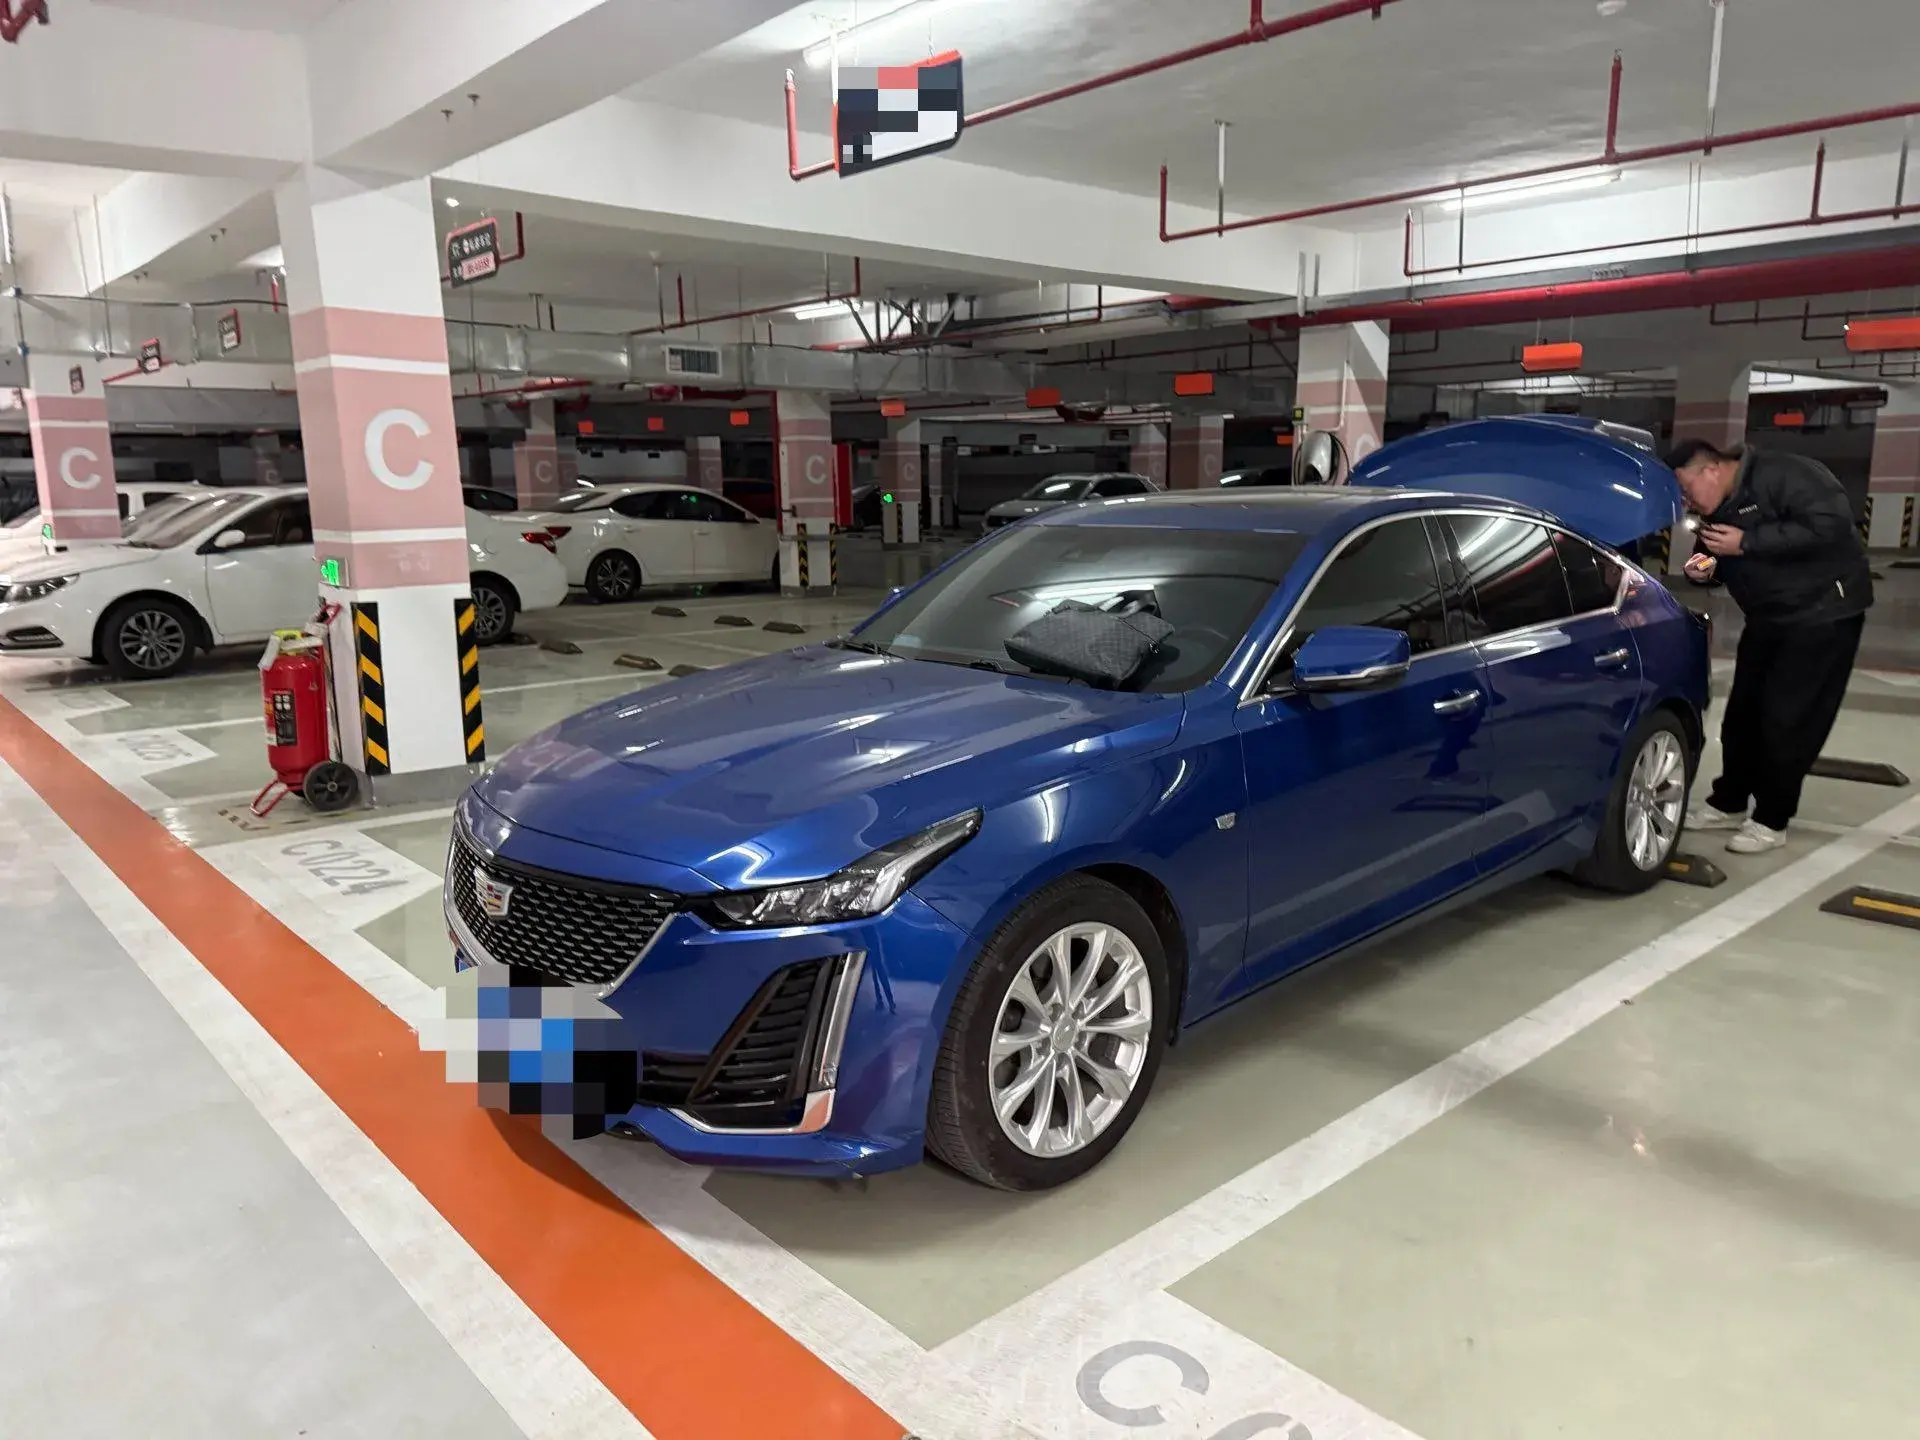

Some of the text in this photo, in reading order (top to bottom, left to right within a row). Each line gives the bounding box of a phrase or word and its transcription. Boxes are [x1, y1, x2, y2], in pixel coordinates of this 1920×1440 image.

[364, 408, 435, 491] C
[60, 447, 102, 490] C
[535, 460, 552, 482] C
[705, 466, 716, 482] C
[806, 455, 827, 484] C
[281, 840, 409, 896] C0224
